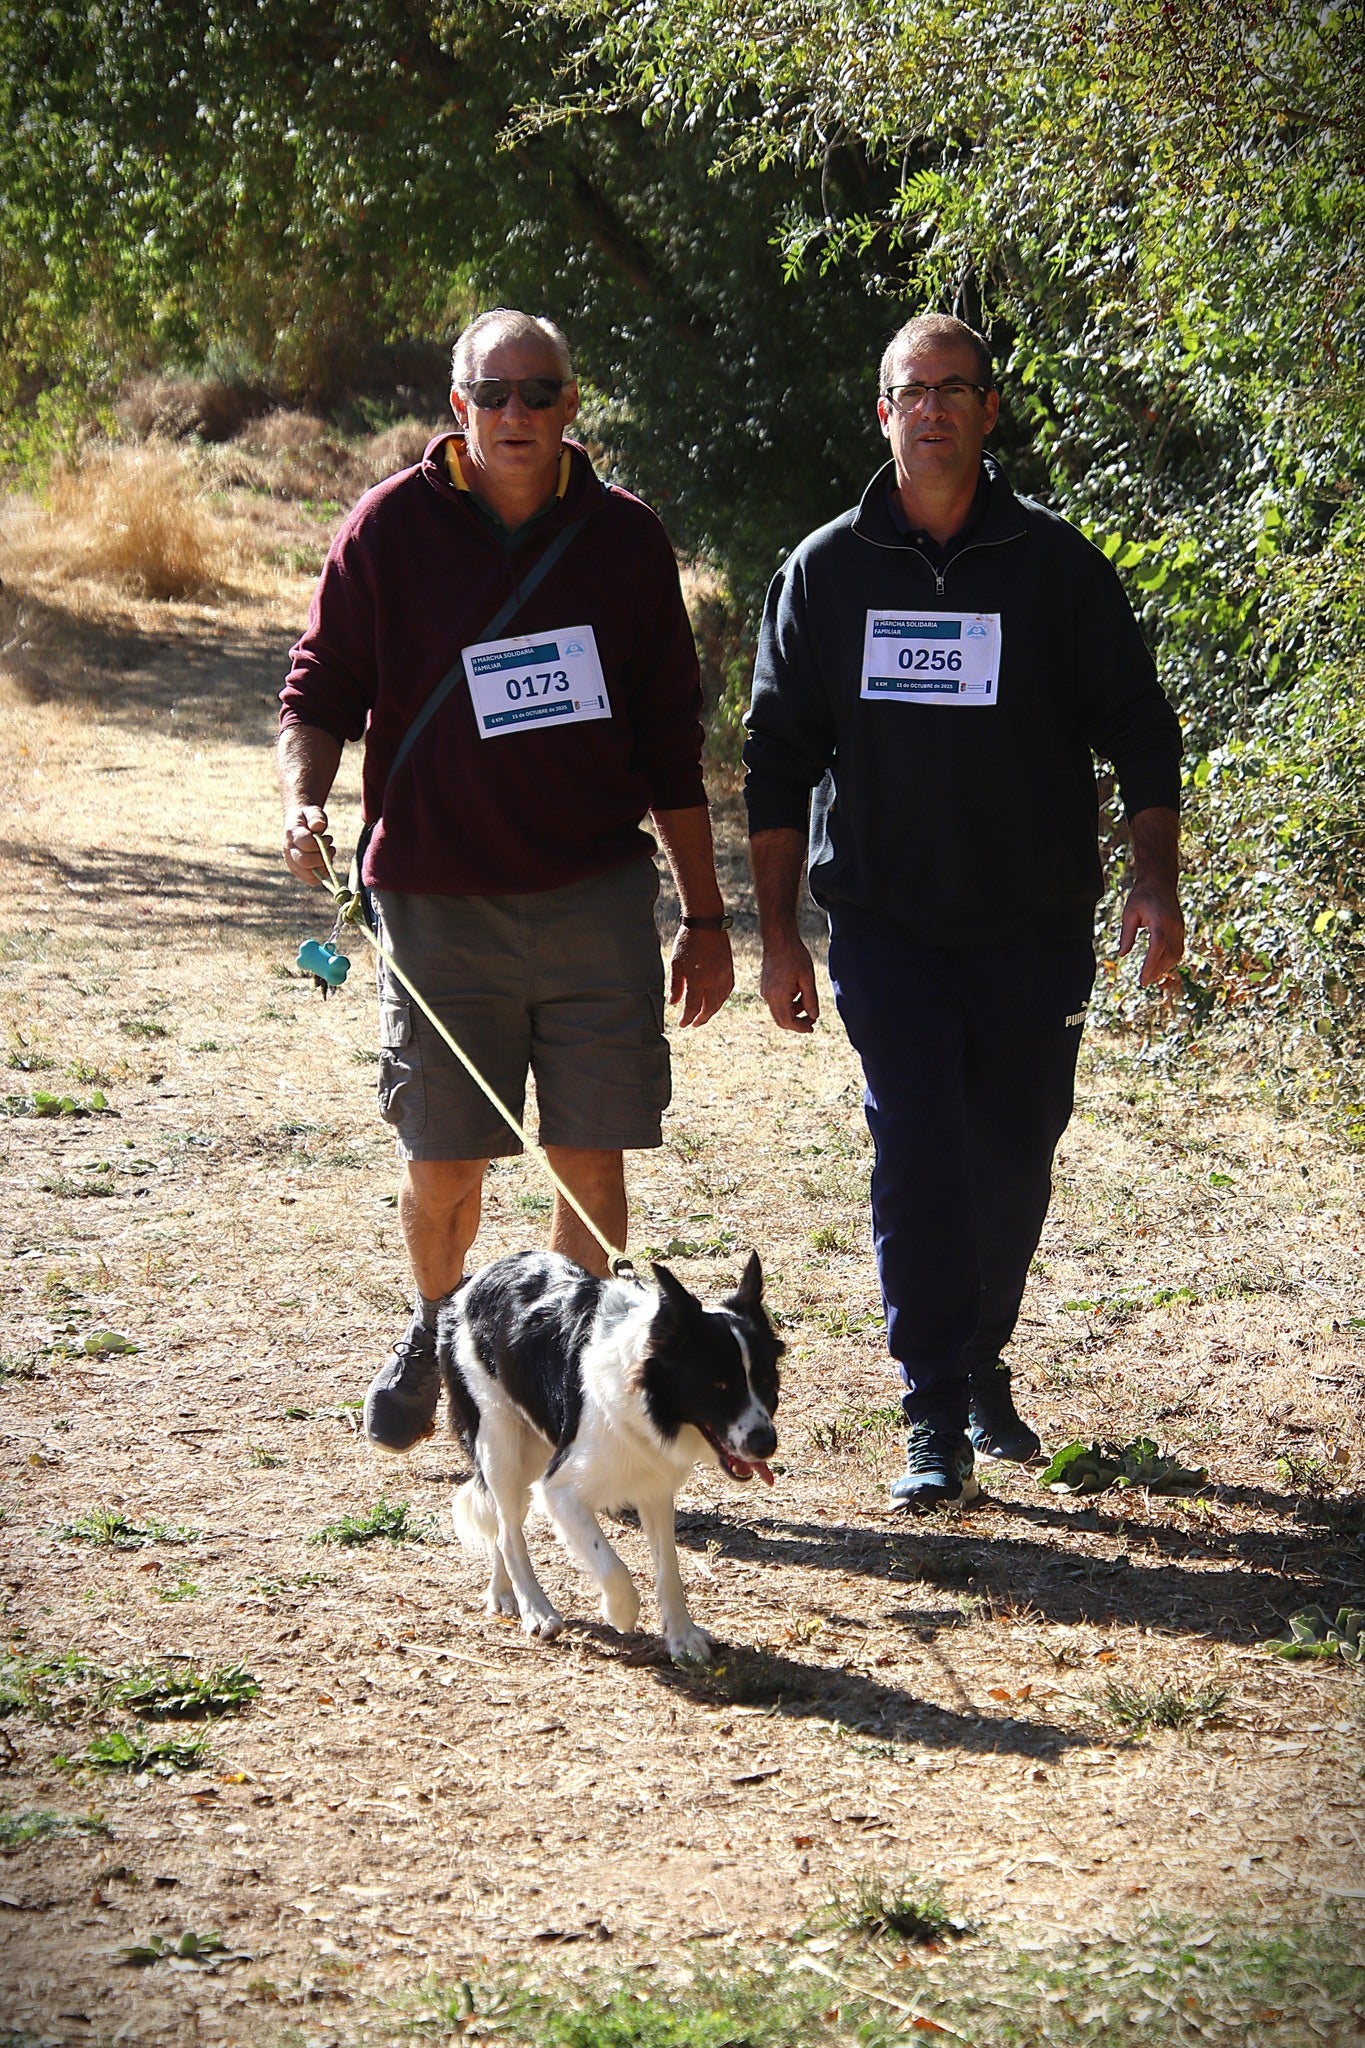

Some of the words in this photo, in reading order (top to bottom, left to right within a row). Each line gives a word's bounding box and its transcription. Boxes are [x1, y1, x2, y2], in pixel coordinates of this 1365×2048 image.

[477, 653, 503, 663] MARCHA
[503, 648, 534, 659] SOLIDARIA
[898, 648, 962, 672] 0256
[474, 663, 501, 672] FAMILIAR
[506, 670, 570, 700] 0173
[526, 708, 548, 717] OCTUBRE
